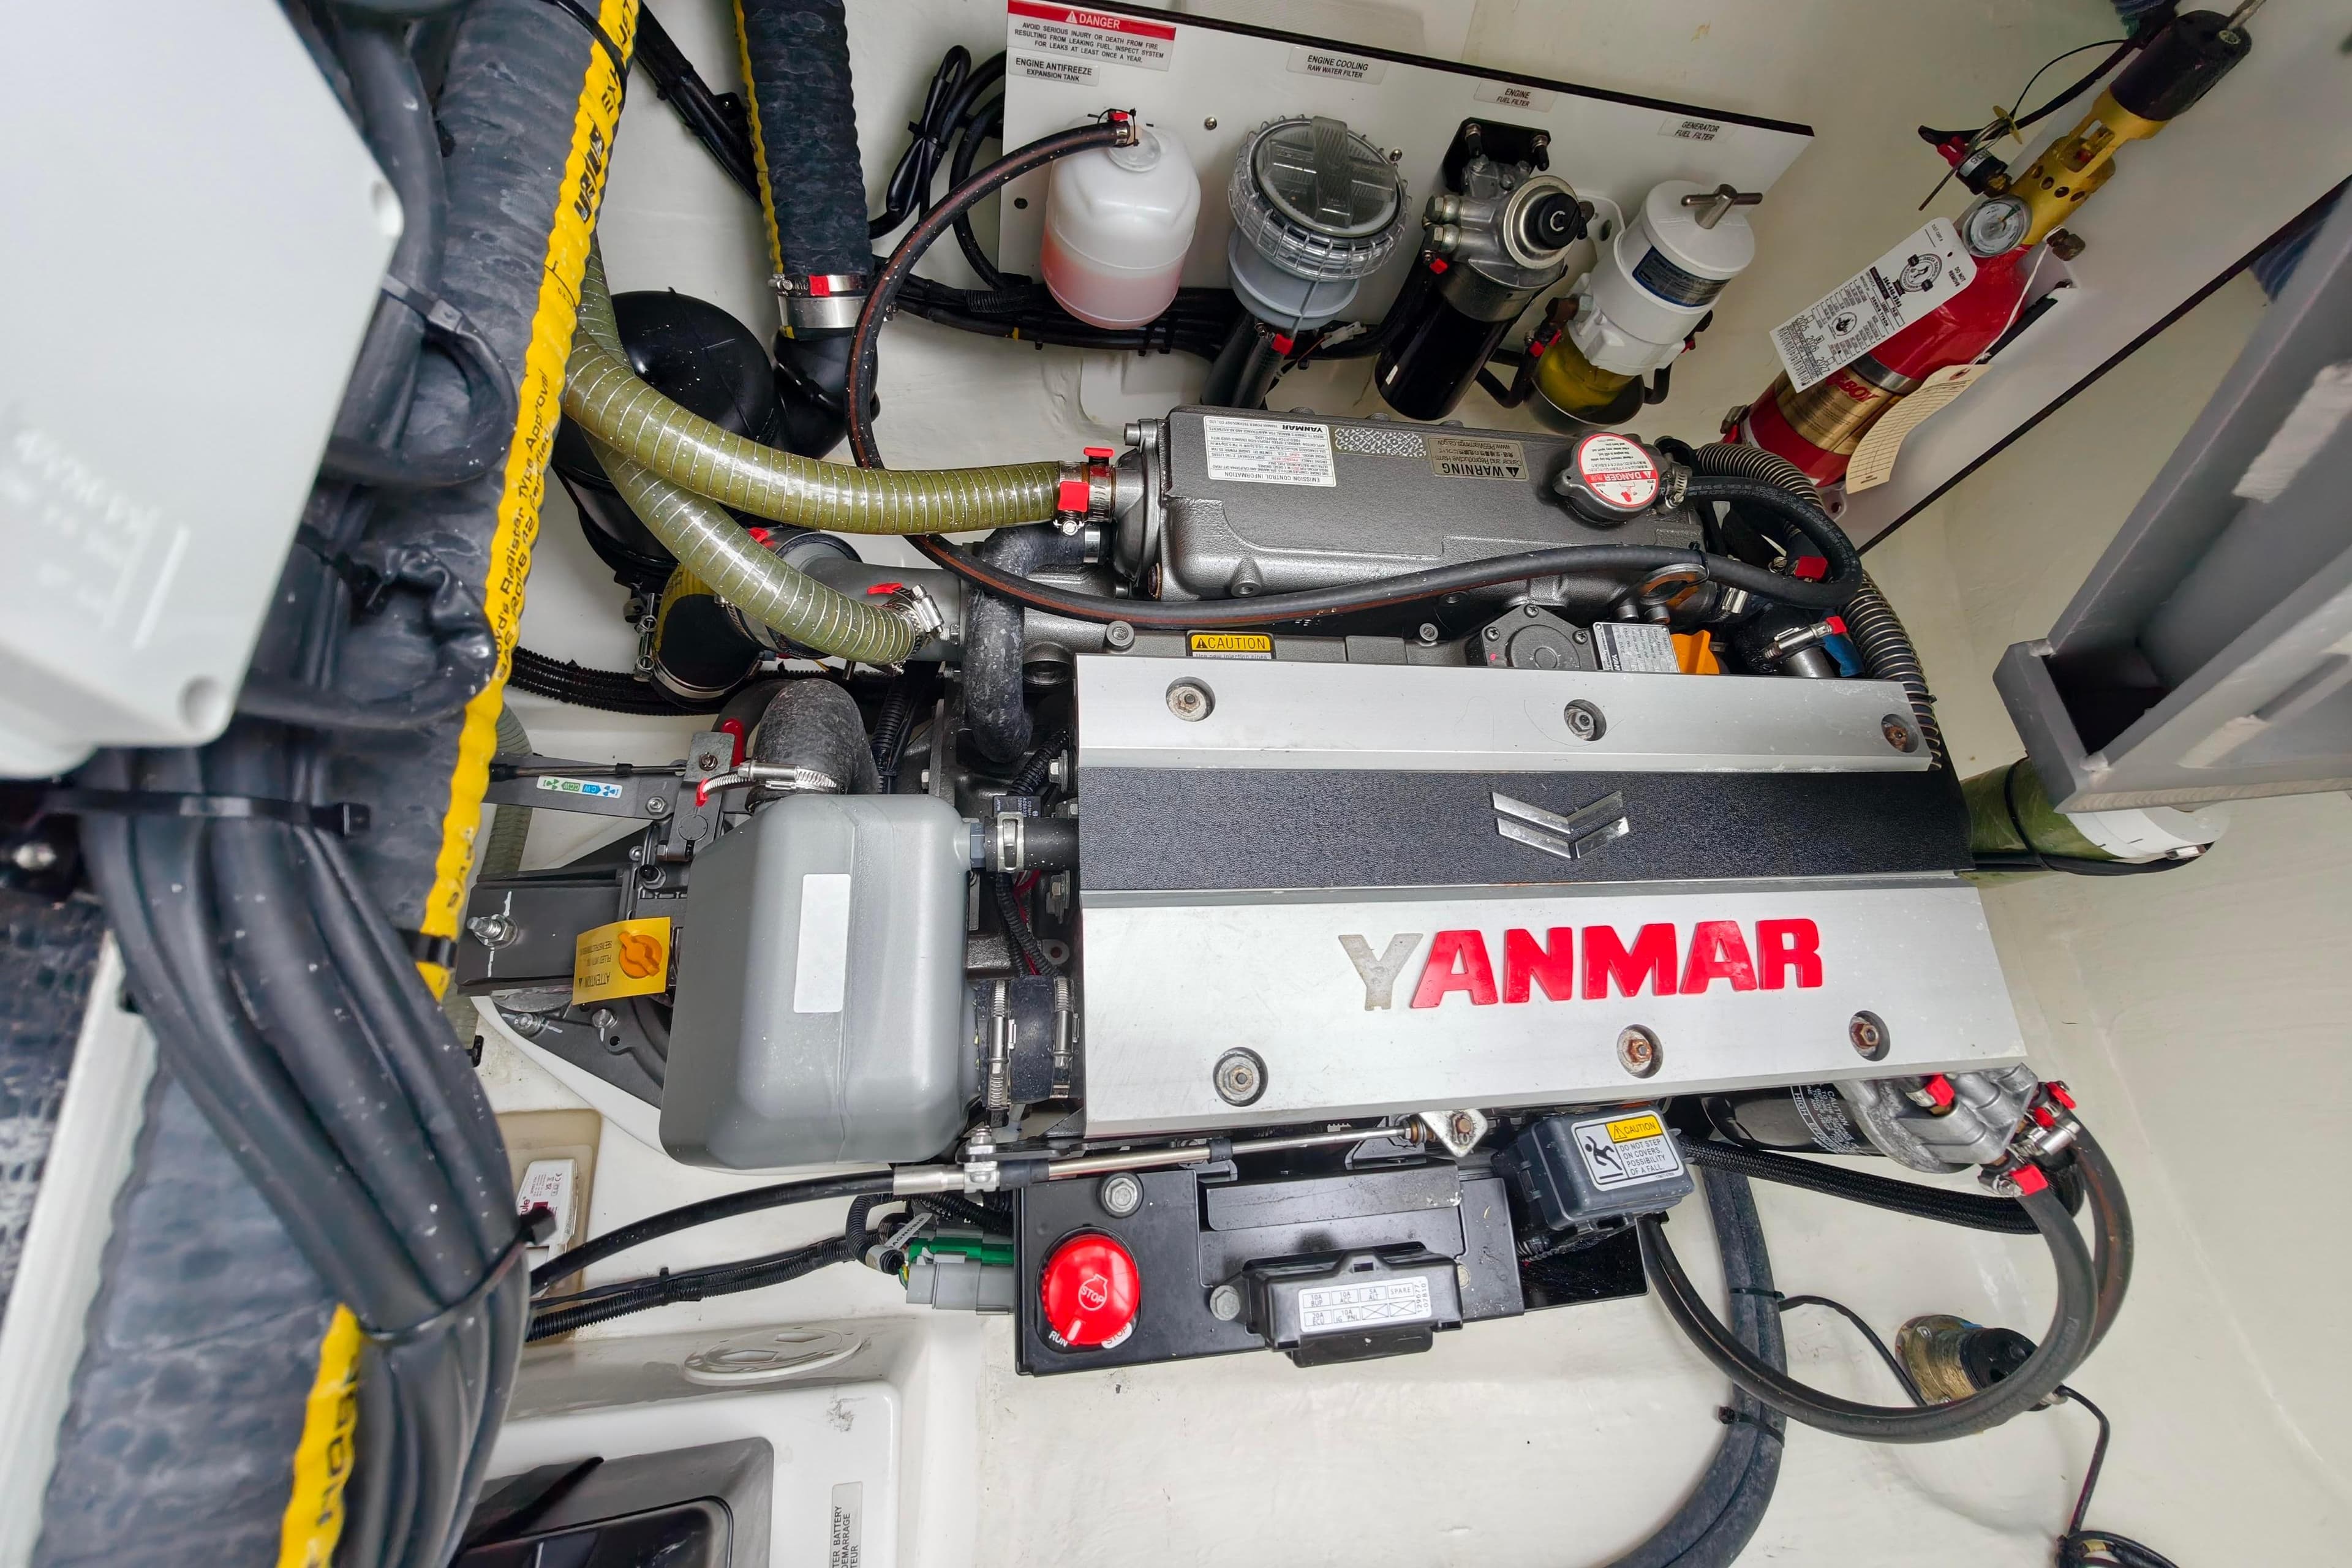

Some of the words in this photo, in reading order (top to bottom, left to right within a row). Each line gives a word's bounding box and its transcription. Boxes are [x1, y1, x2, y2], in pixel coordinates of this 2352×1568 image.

[1078, 13, 1120, 30] DANGER
[1043, 25, 1068, 34] SERIOUS
[1071, 30, 1091, 39] INJURY
[1105, 36, 1124, 44] DEATH
[1014, 29, 1047, 39] RESULTING
[1069, 37, 1094, 47] LEAKING
[1115, 45, 1138, 54] INSPECT
[1141, 50, 1164, 58] SYSTEM
[1015, 57, 1044, 69] ENGINE
[1046, 61, 1092, 76] ANTIFREEZE
[1307, 55, 1335, 66] ENGINE
[1335, 59, 1368, 70] COOLING
[1026, 68, 1061, 79] EXPANSION
[1322, 66, 1343, 75] WATER
[1343, 69, 1363, 78] FILTER
[1504, 88, 1531, 99] ENGINE
[1510, 98, 1529, 107] FILTER
[1681, 120, 1719, 133] GENERATOR
[1675, 129, 1691, 137] FUEL
[1692, 131, 1714, 141] FILTER
[1795, 314, 1810, 332] 2025
[1805, 334, 1820, 353] 2026
[1815, 356, 1831, 374] 2027
[526, 369, 546, 451] Approval
[1452, 454, 1488, 464] Reproductive
[1224, 470, 1263, 479] INFORMATION
[1441, 461, 1504, 478] WARNING
[1604, 471, 1641, 481] DANGER
[520, 458, 535, 498] Type
[500, 508, 524, 593] Register
[1208, 636, 1266, 650] CAUTION
[1611, 654, 1621, 671] YAN
[1338, 918, 1823, 1011] YANMAR
[1795, 1092, 1808, 1118] HIGH
[1810, 1096, 1819, 1111] AND
[1828, 1089, 1849, 1126] CAUTION
[1624, 1121, 1656, 1134] CAUTION
[1635, 1147, 1662, 1157] COVERS.
[1626, 1154, 1666, 1167] POSSIBILITY
[1647, 1163, 1665, 1172] FALL.
[1080, 1286, 1104, 1303] STOP
[1049, 1330, 1068, 1348] RUN
[833, 1506, 842, 1545] BATTERY
